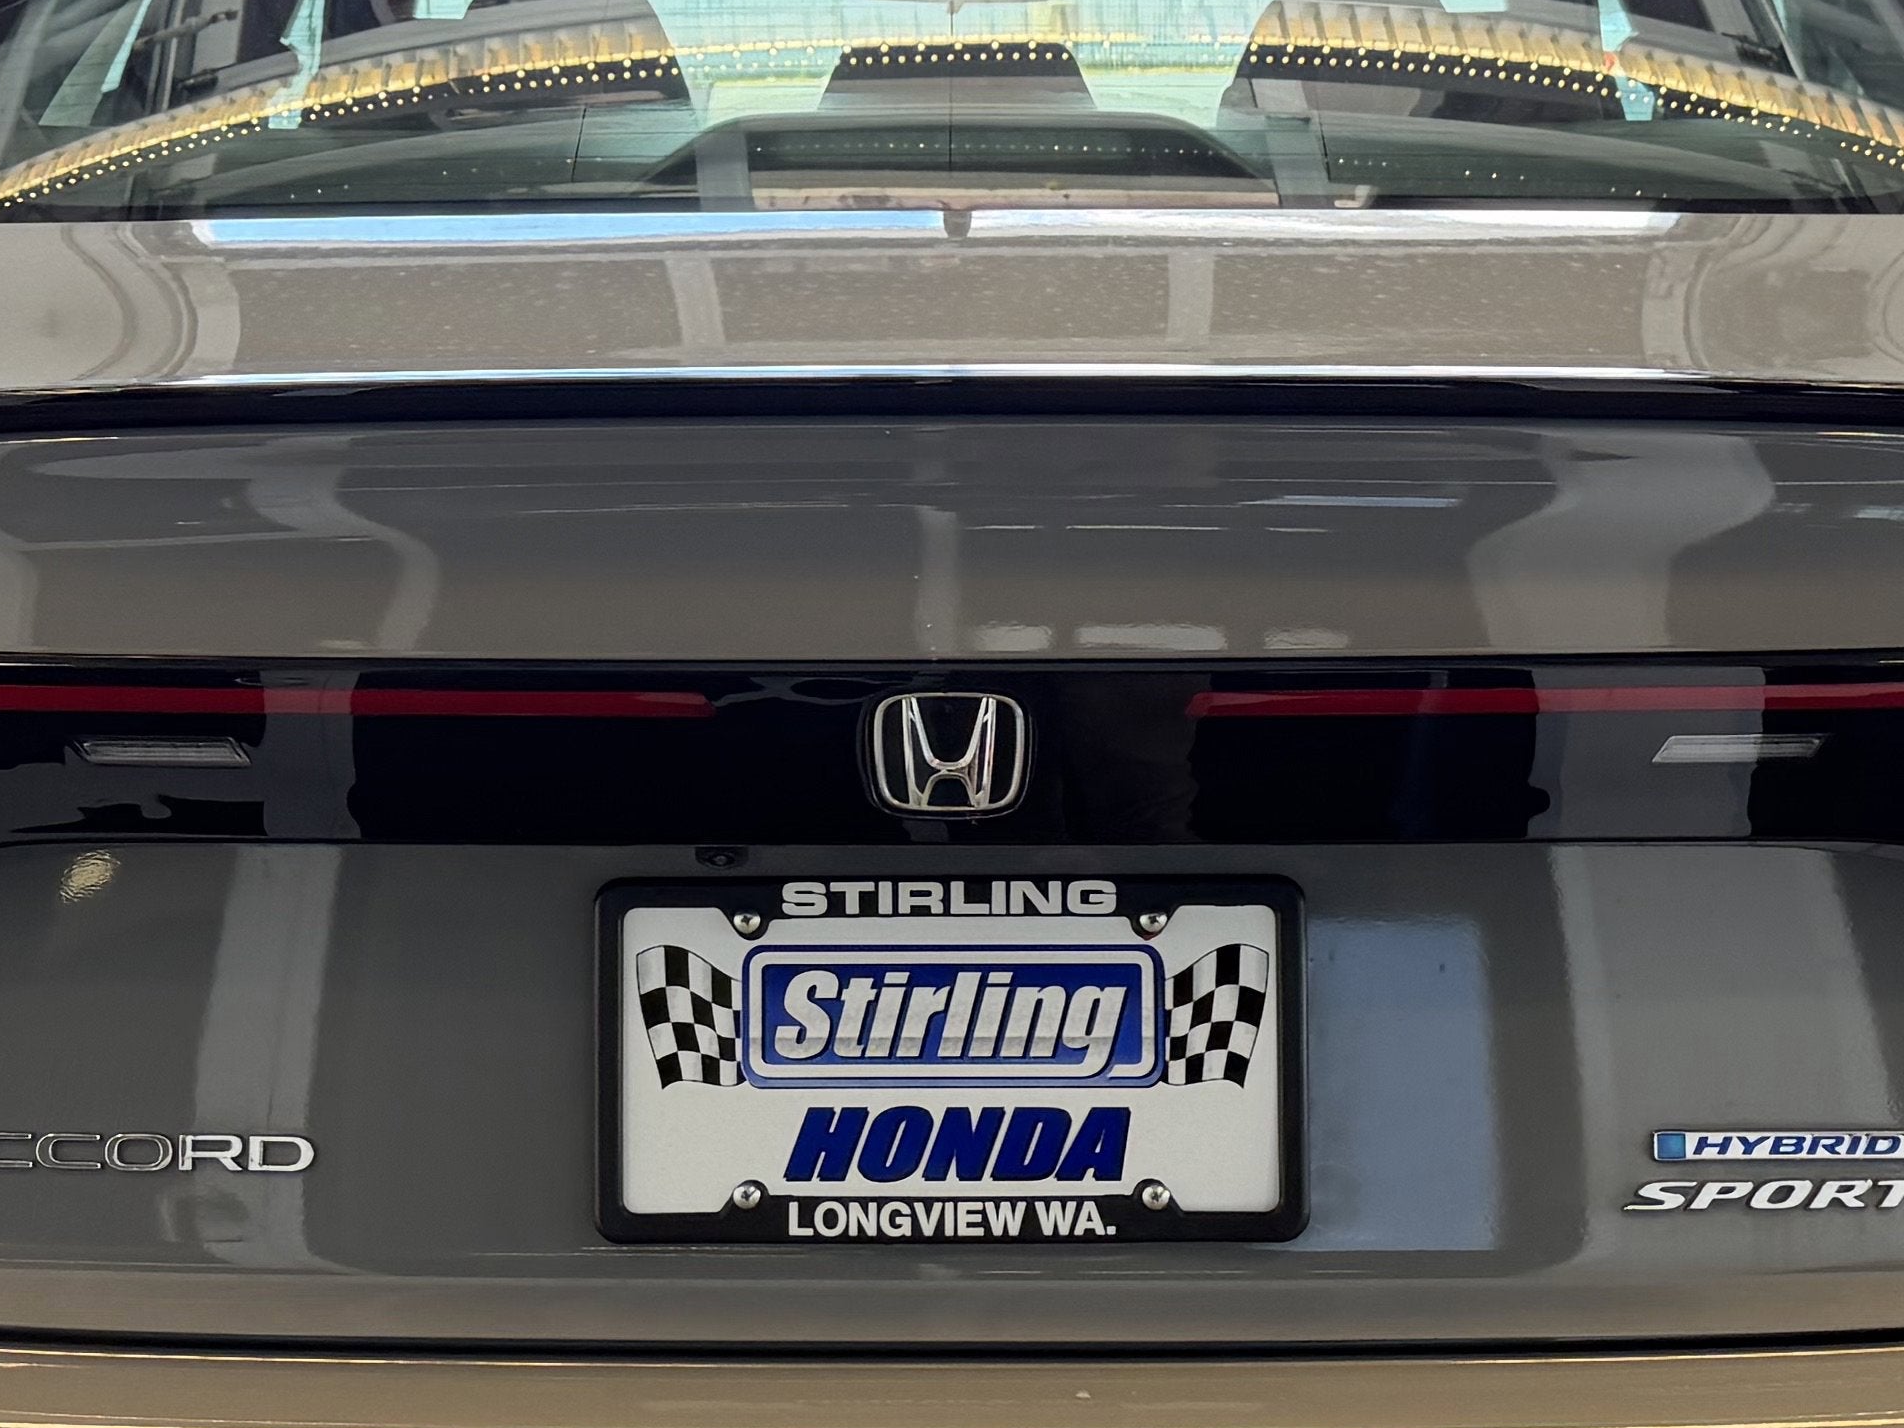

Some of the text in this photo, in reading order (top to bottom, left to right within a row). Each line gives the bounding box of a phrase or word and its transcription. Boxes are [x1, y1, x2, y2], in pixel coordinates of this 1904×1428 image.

[782, 880, 1118, 916] STIRLING
[774, 970, 1126, 1078] Stirling
[783, 1107, 1131, 1183] HONDA
[1693, 1136, 1901, 1155] HYBRID
[787, 1202, 1116, 1237] LONGVIEW WA.
